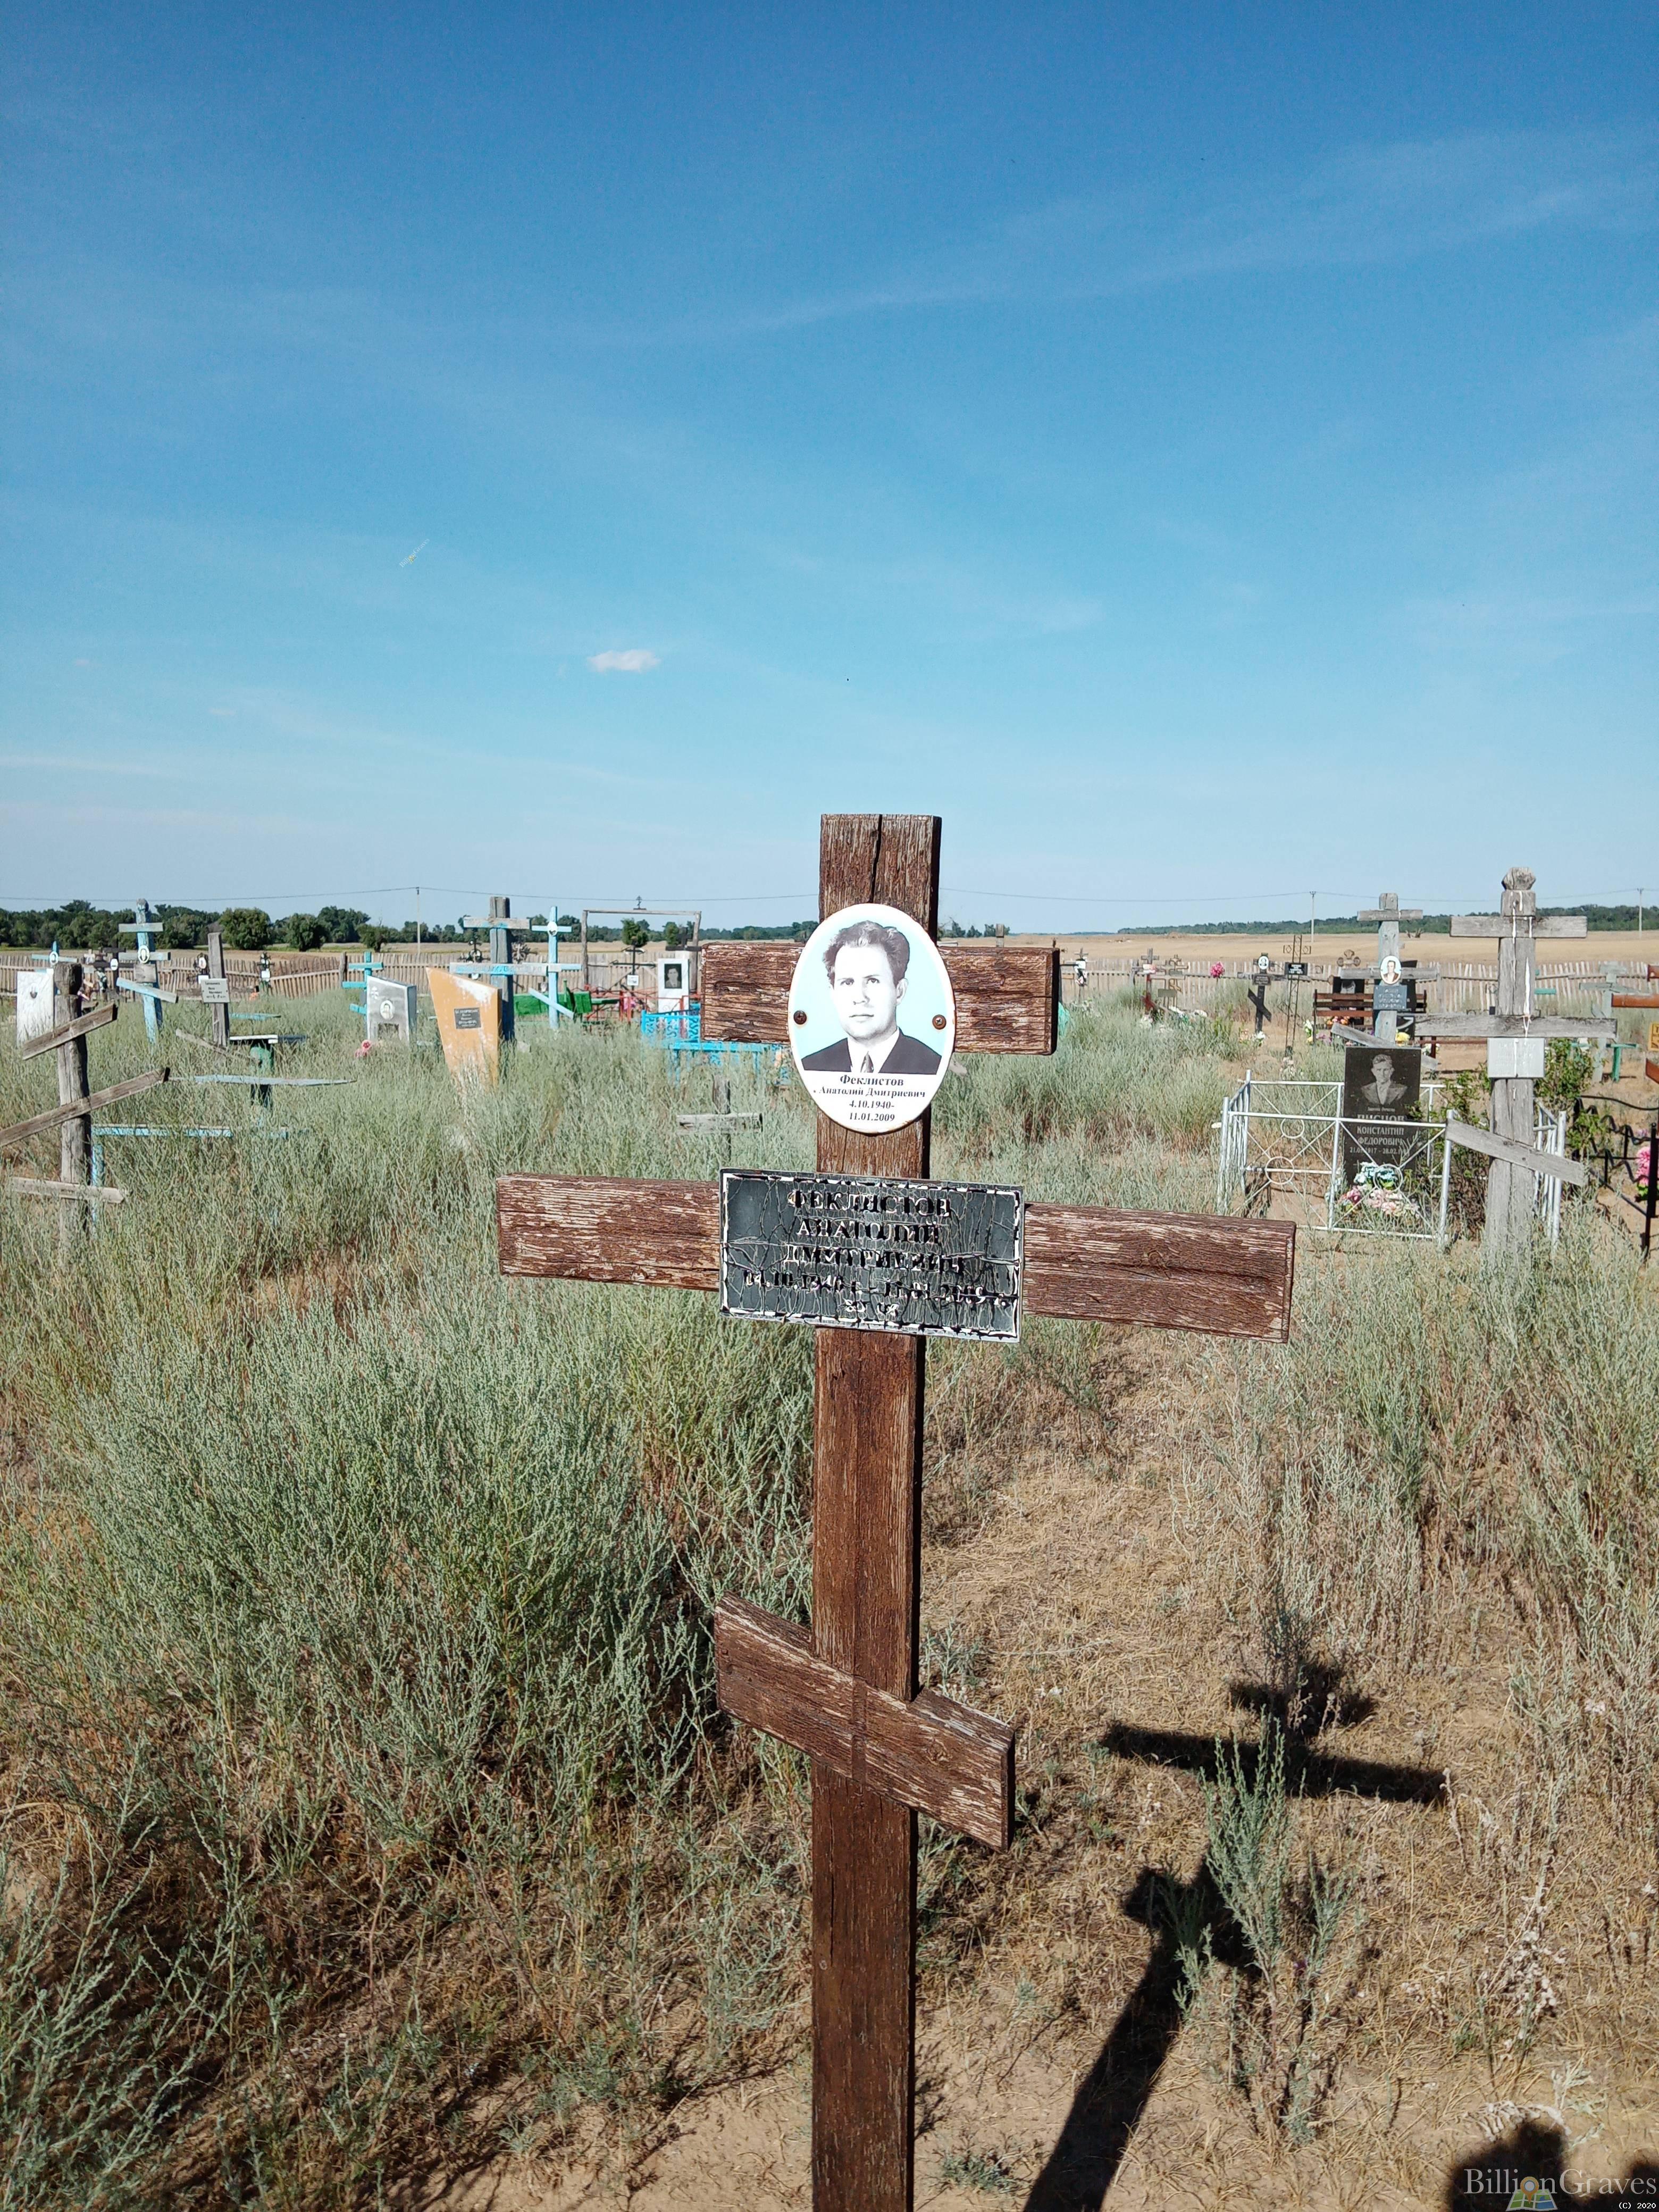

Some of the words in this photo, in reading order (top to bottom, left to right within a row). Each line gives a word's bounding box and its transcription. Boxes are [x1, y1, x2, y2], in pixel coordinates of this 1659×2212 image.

[840, 1074, 904, 1086] Феклистов
[819, 1086, 864, 1095] Анатолий
[865, 1087, 926, 1099] Дмитриевич
[849, 1112, 895, 1121] 11.01.2009
[1356, 1126, 1404, 1135] КОНСТАНТИН
[1358, 1136, 1403, 1146] ФЕДОРОВИЧ
[787, 1189, 951, 1217] ФЕКЛИСТОВ
[797, 1218, 941, 1245] АНАТОЛИЙ
